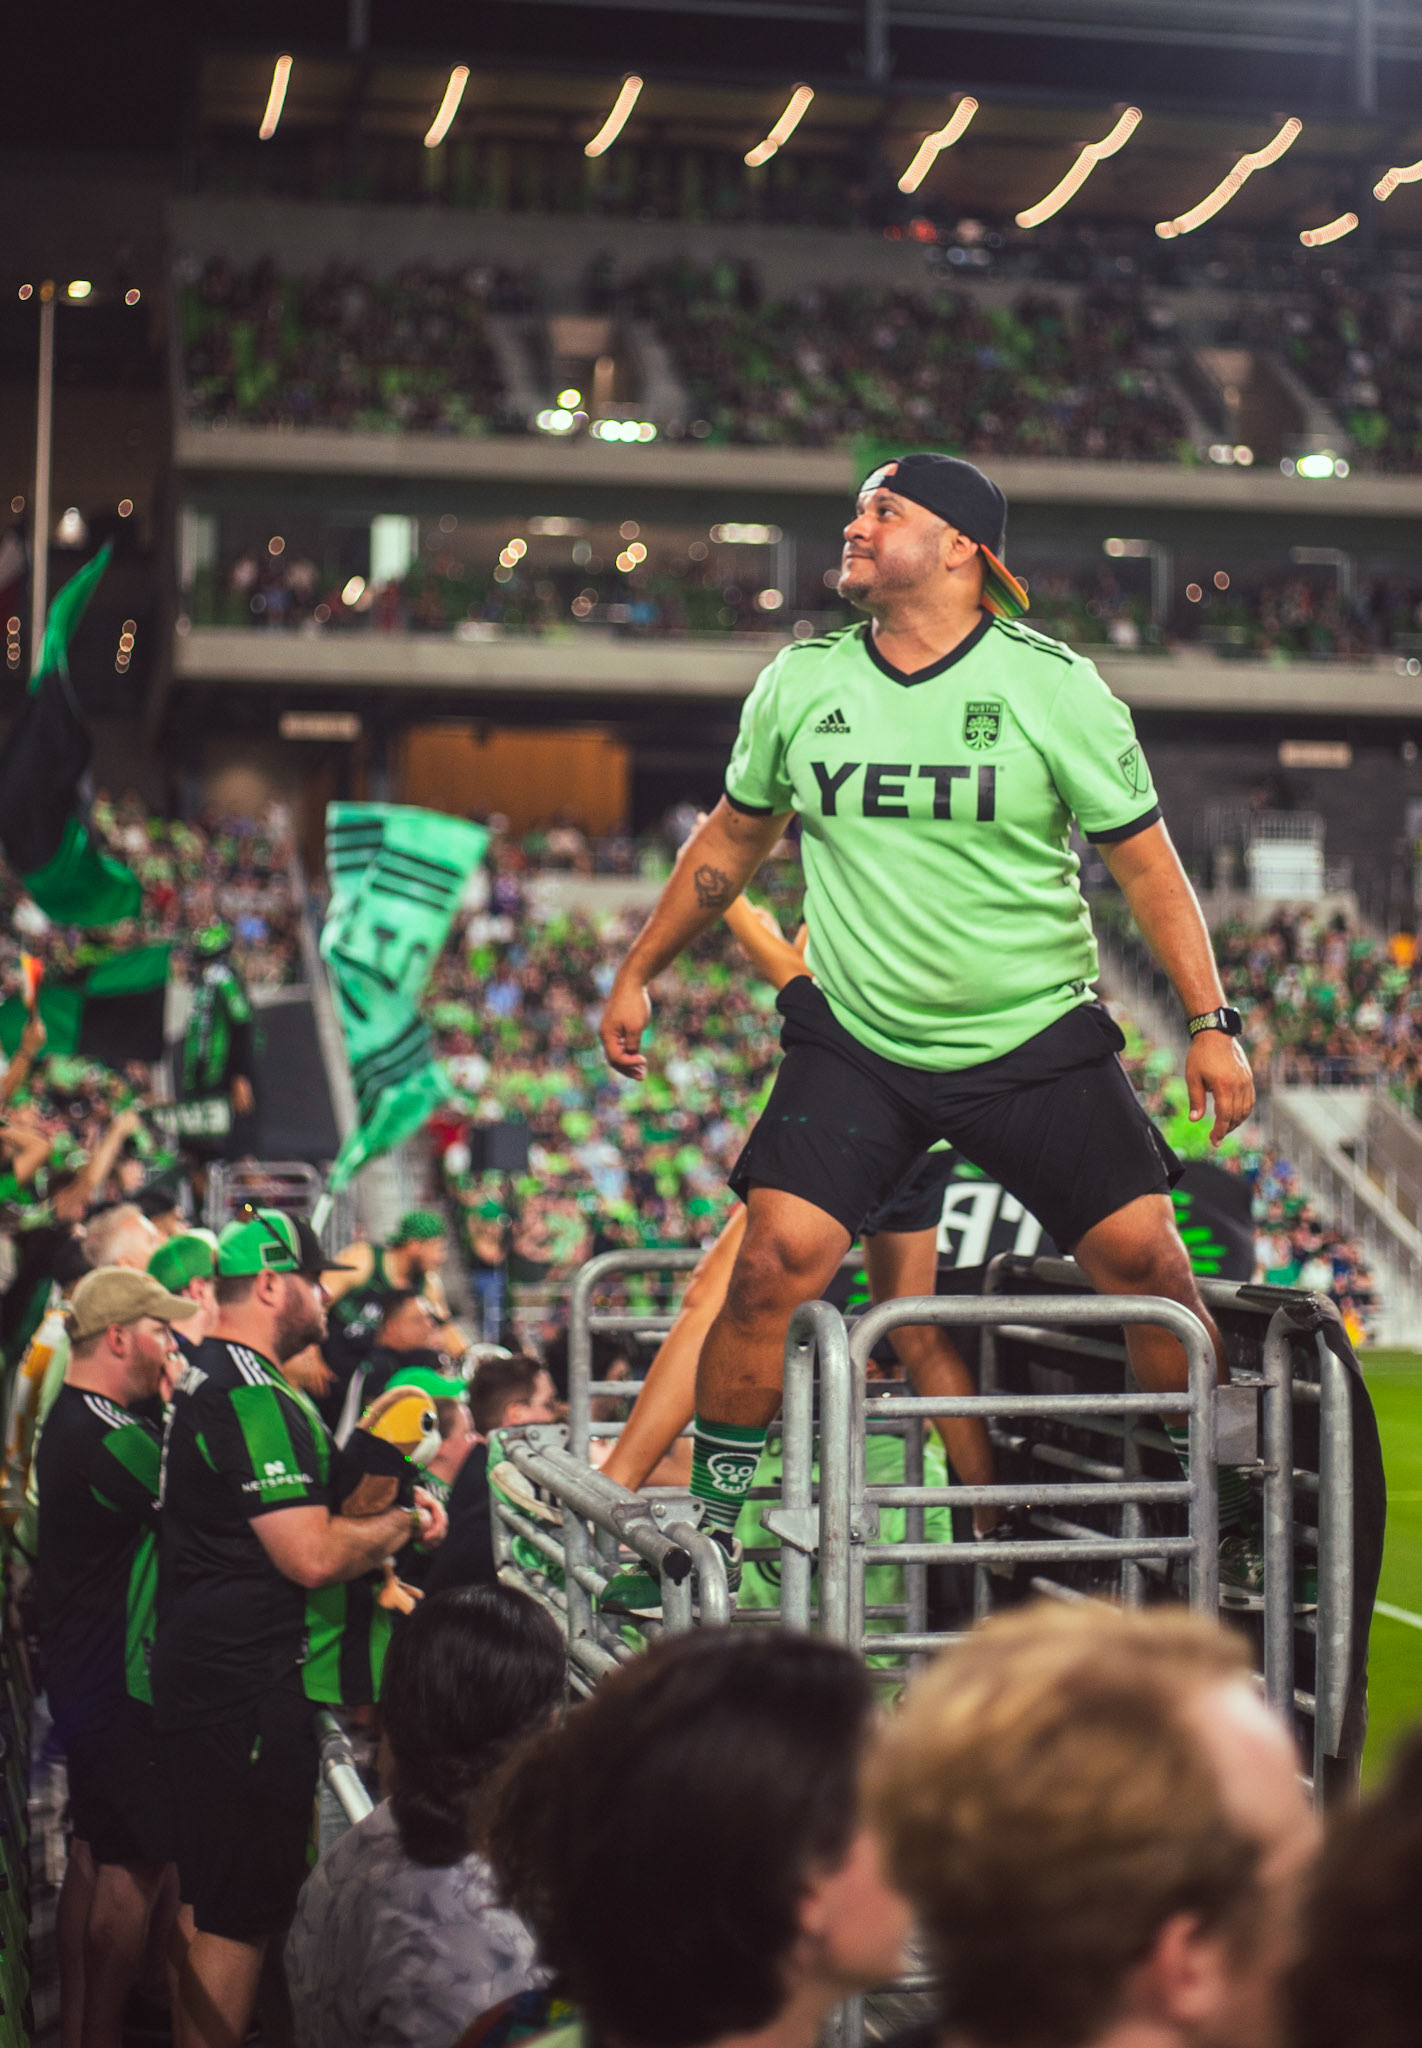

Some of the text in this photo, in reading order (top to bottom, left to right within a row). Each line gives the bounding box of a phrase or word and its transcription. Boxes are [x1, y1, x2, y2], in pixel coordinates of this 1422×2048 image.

[968, 704, 1000, 713] AUSTIN
[815, 723, 851, 734] adidas
[810, 761, 996, 822] YETI
